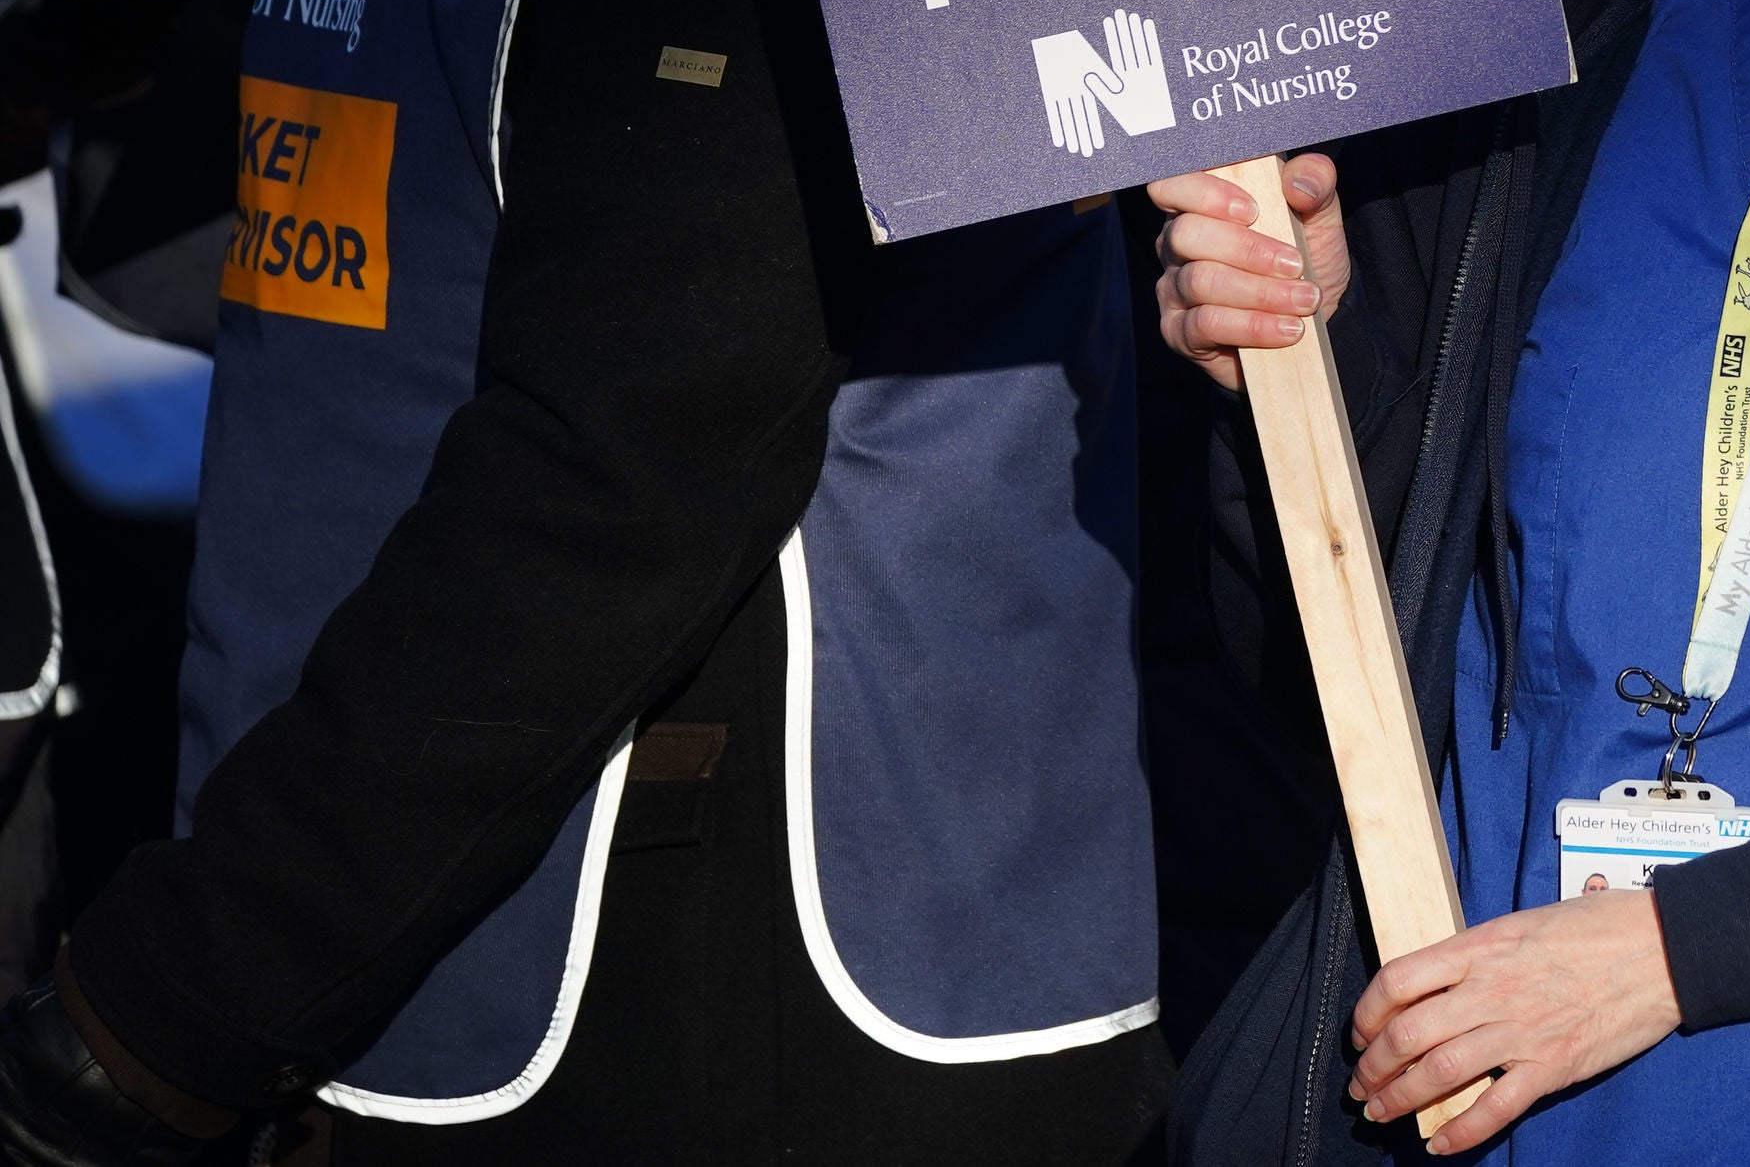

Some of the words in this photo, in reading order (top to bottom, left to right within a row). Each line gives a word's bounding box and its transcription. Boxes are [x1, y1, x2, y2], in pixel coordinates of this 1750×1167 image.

[1181, 29, 1270, 82] Royal
[1275, 10, 1393, 50] College
[661, 58, 721, 74] MARCIANO
[1191, 84, 1223, 121] of
[1231, 64, 1358, 113] Nursing
[1721, 335, 1745, 377] NHS
[1718, 384, 1738, 454] Children's
[1737, 408, 1749, 458] Foundation
[1717, 459, 1733, 486] Hey
[1736, 462, 1745, 480] NHS
[1715, 492, 1728, 534] Alder
[1714, 580, 1743, 617] My
[1566, 816, 1605, 829] Alder
[1610, 818, 1637, 833] Hey
[1642, 819, 1711, 835] Children's
[1616, 835, 1635, 844] NHS
[1636, 836, 1687, 847] Foundation
[1688, 839, 1710, 848] Trust
